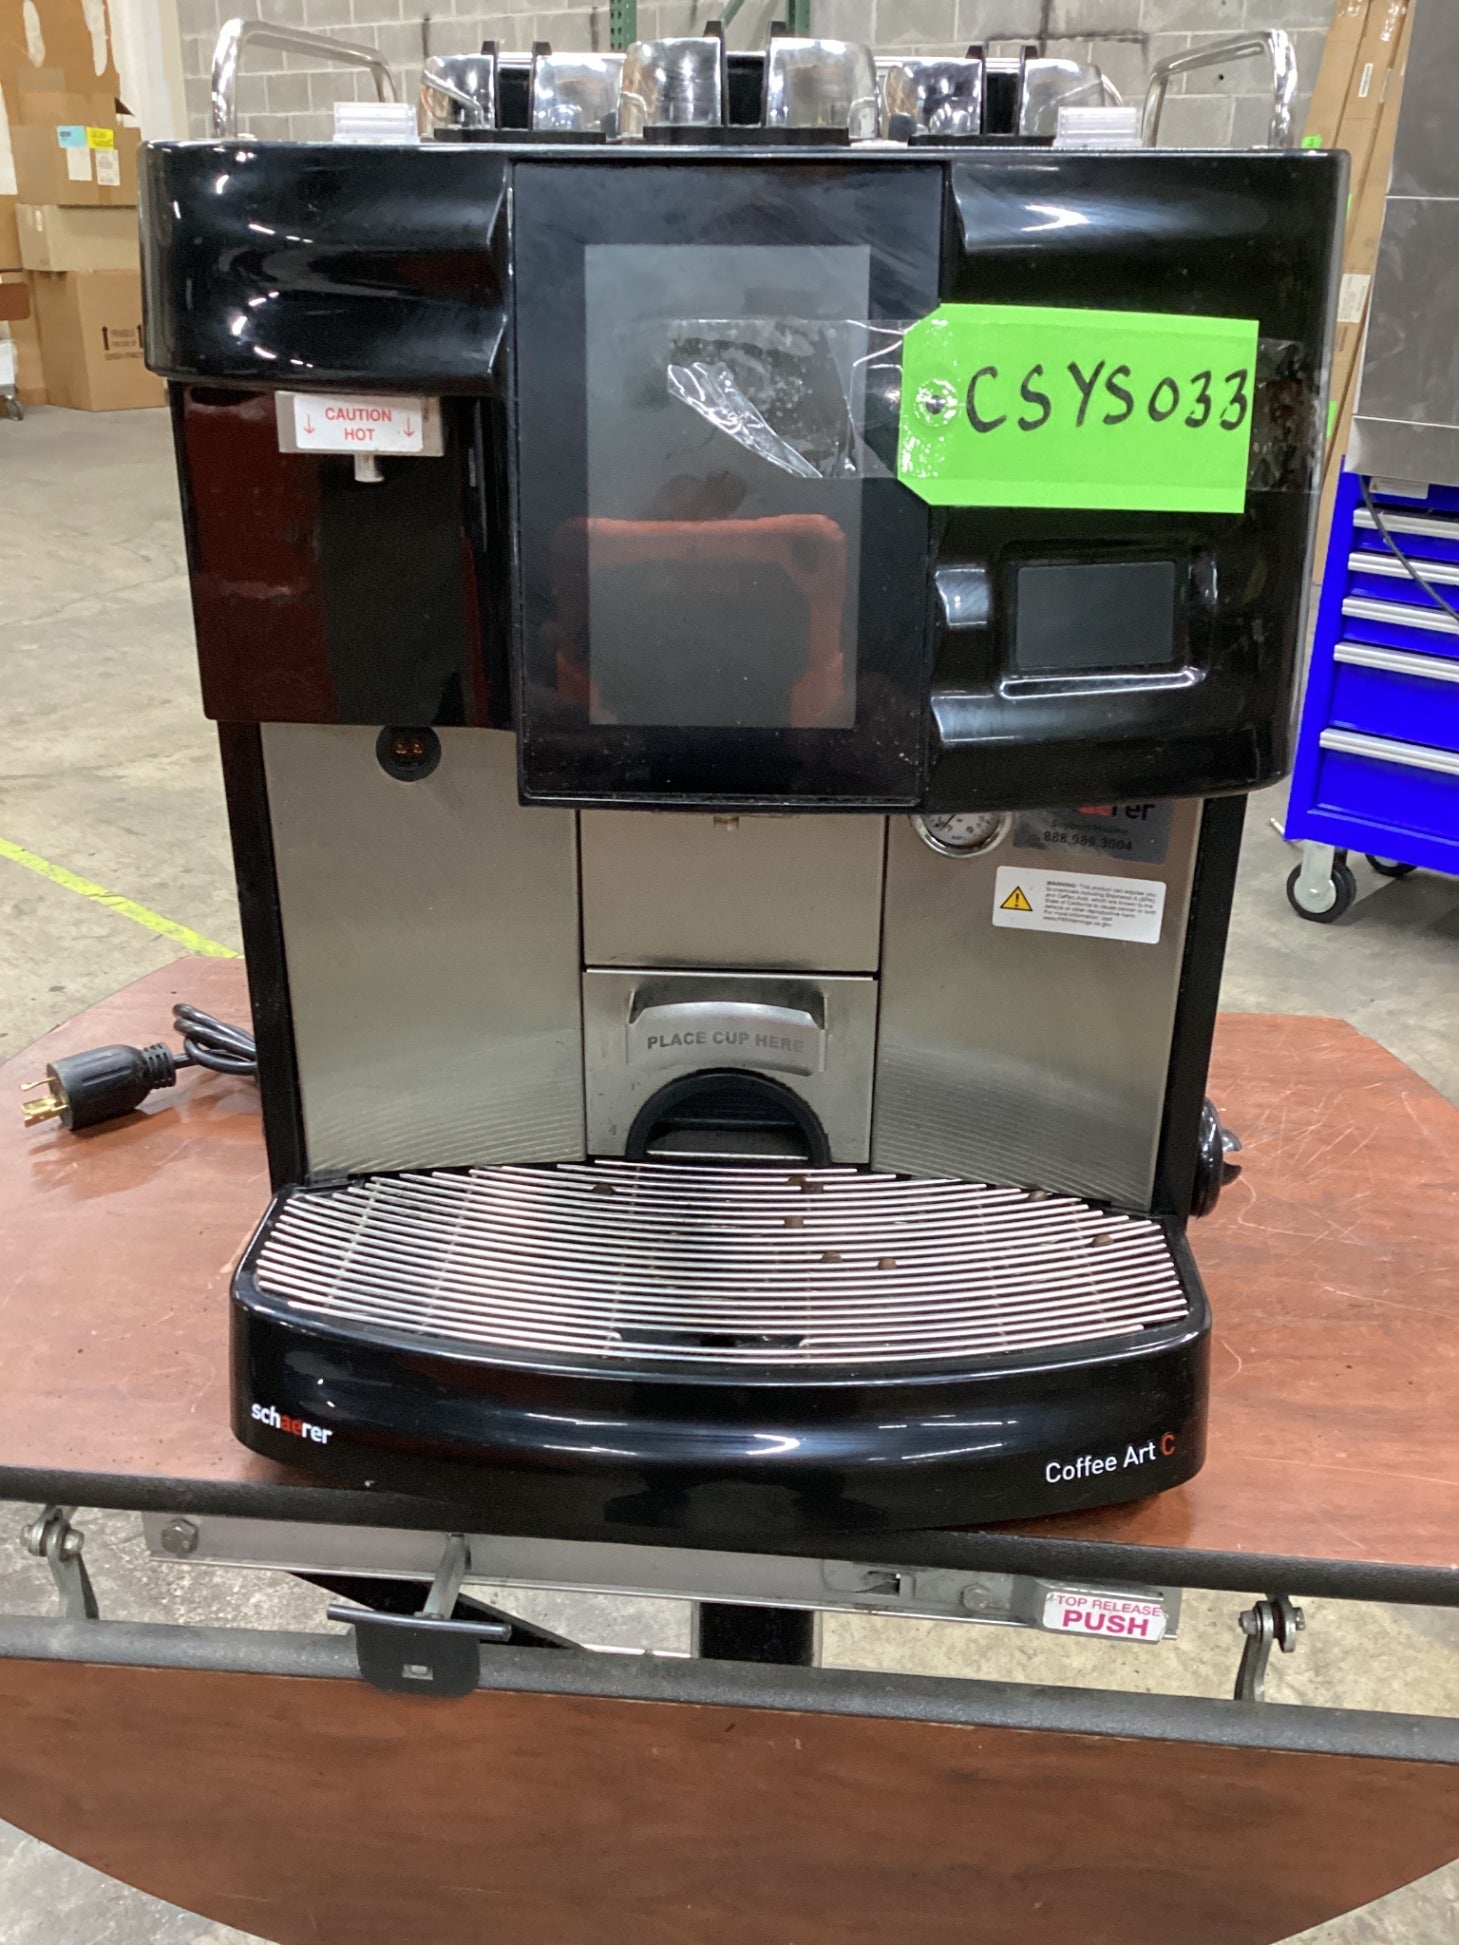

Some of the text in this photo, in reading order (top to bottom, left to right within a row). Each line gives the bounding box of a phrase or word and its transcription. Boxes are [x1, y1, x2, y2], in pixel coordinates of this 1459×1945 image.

[966, 360, 1248, 433] CSYS033
[325, 407, 392, 422] CAUTION
[344, 428, 375, 441] HOT
[647, 1031, 804, 1052] PLACE CUP HERE
[251, 1403, 333, 1444] schaerer
[1045, 1431, 1176, 1483] Coffee Art C
[1056, 1595, 1162, 1617] TOP RELEASE
[1062, 1609, 1149, 1636] PUSH
